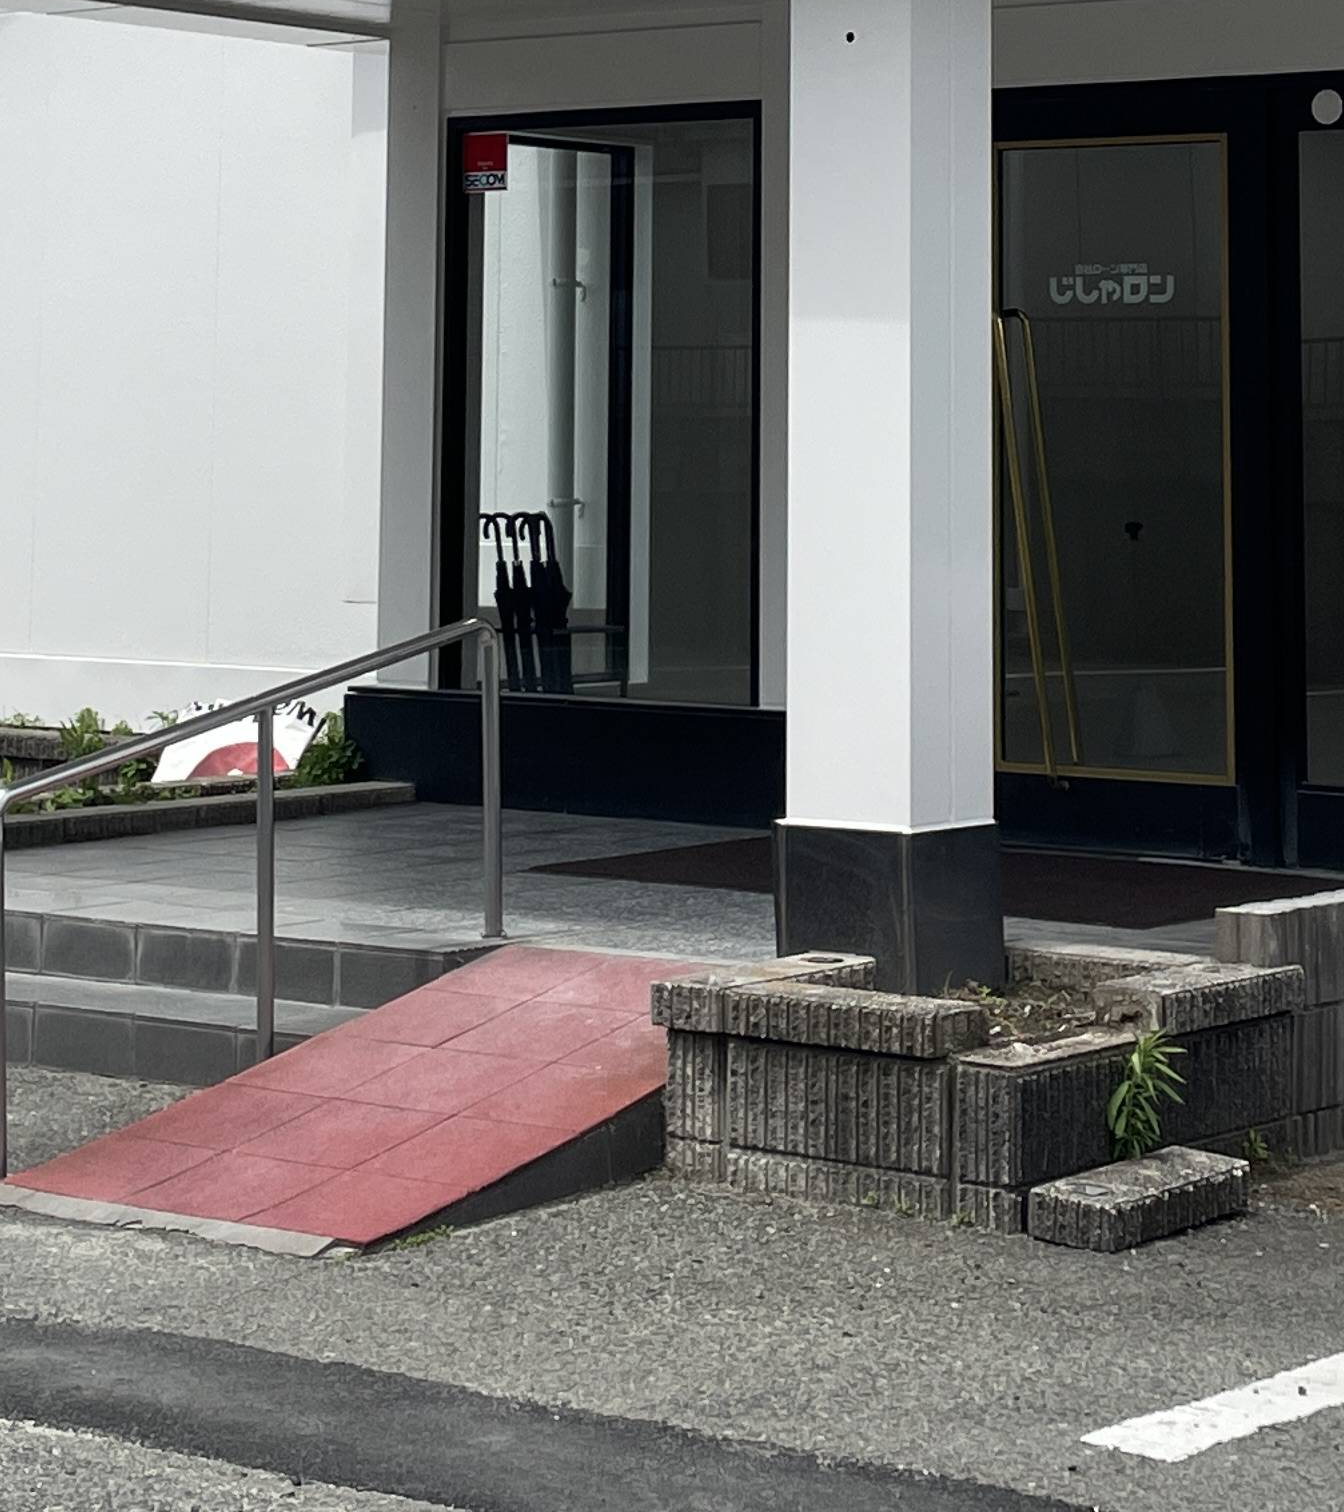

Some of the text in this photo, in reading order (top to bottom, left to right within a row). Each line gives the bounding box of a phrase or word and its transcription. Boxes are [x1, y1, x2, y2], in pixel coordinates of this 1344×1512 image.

[464, 174, 505, 187] SECOM
[1049, 275, 1175, 305] じしゃロン
